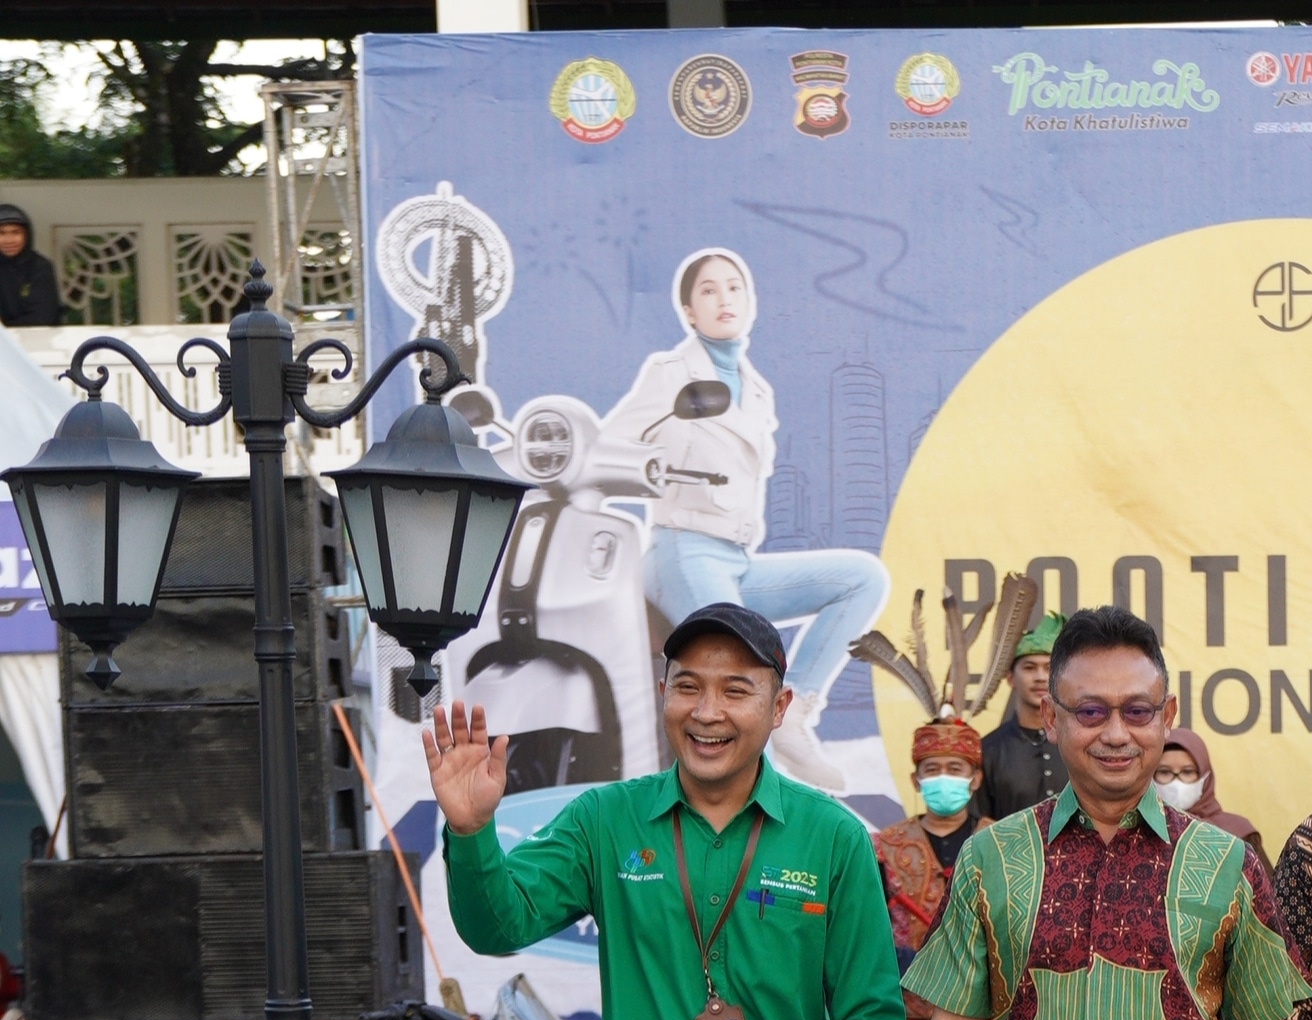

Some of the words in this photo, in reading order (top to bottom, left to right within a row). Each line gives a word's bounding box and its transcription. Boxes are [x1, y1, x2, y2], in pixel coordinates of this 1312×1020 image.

[991, 52, 1220, 115] Pontianak
[1025, 115, 1067, 131] Kota
[1073, 114, 1188, 130] Khatulistiwa
